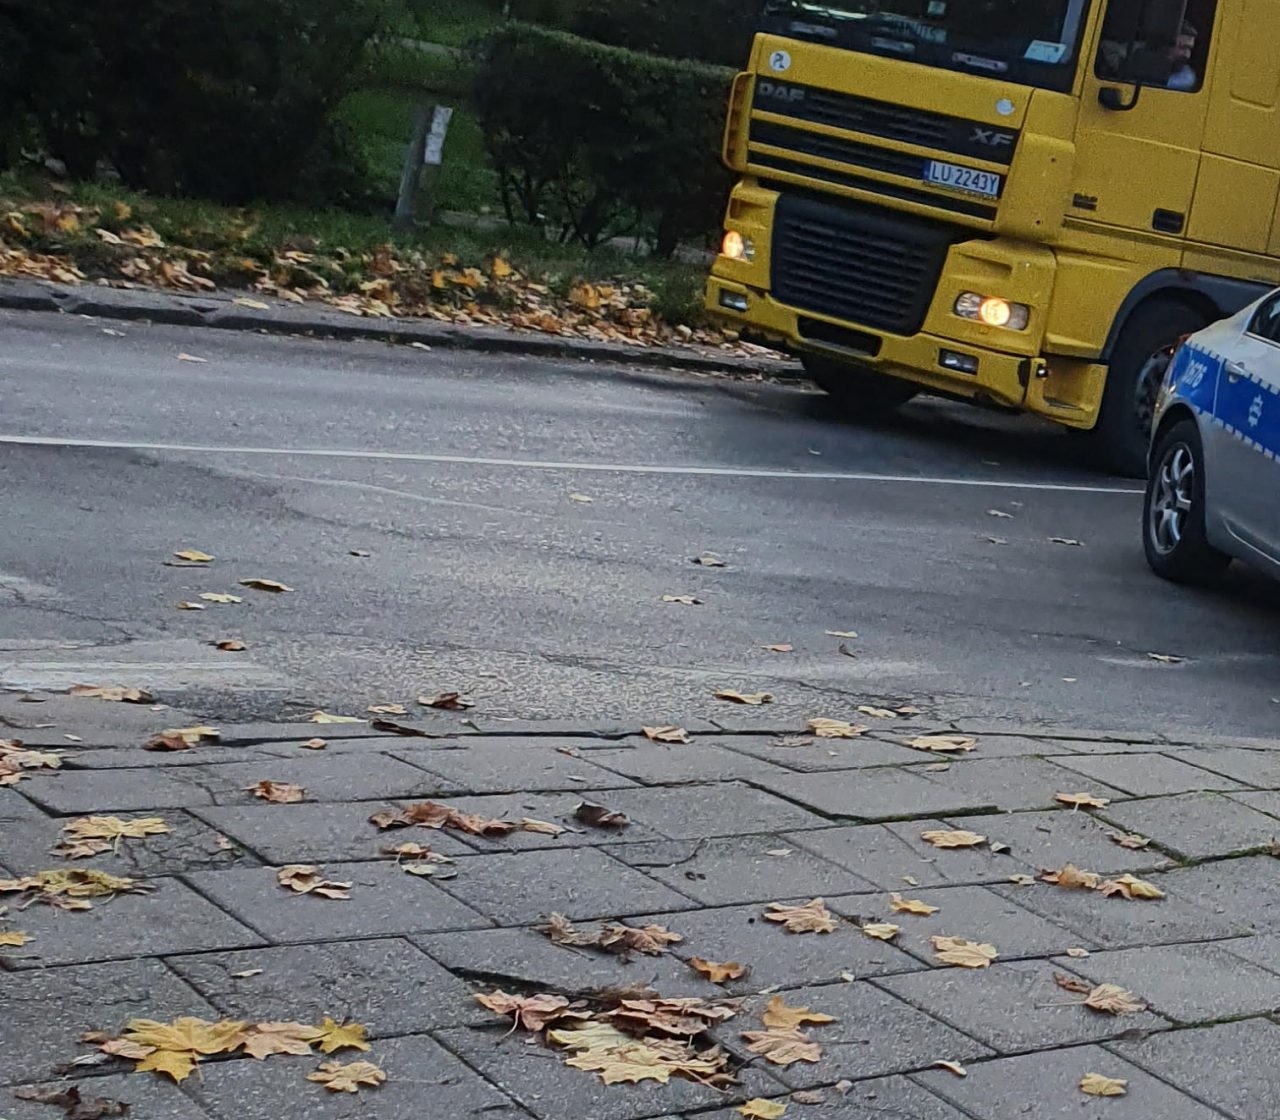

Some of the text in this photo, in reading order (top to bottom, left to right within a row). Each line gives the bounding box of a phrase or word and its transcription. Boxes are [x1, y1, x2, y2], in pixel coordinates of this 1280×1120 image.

[760, 82, 805, 101] DAF
[970, 127, 1014, 146] XF
[931, 163, 997, 192] LU 2243Y
